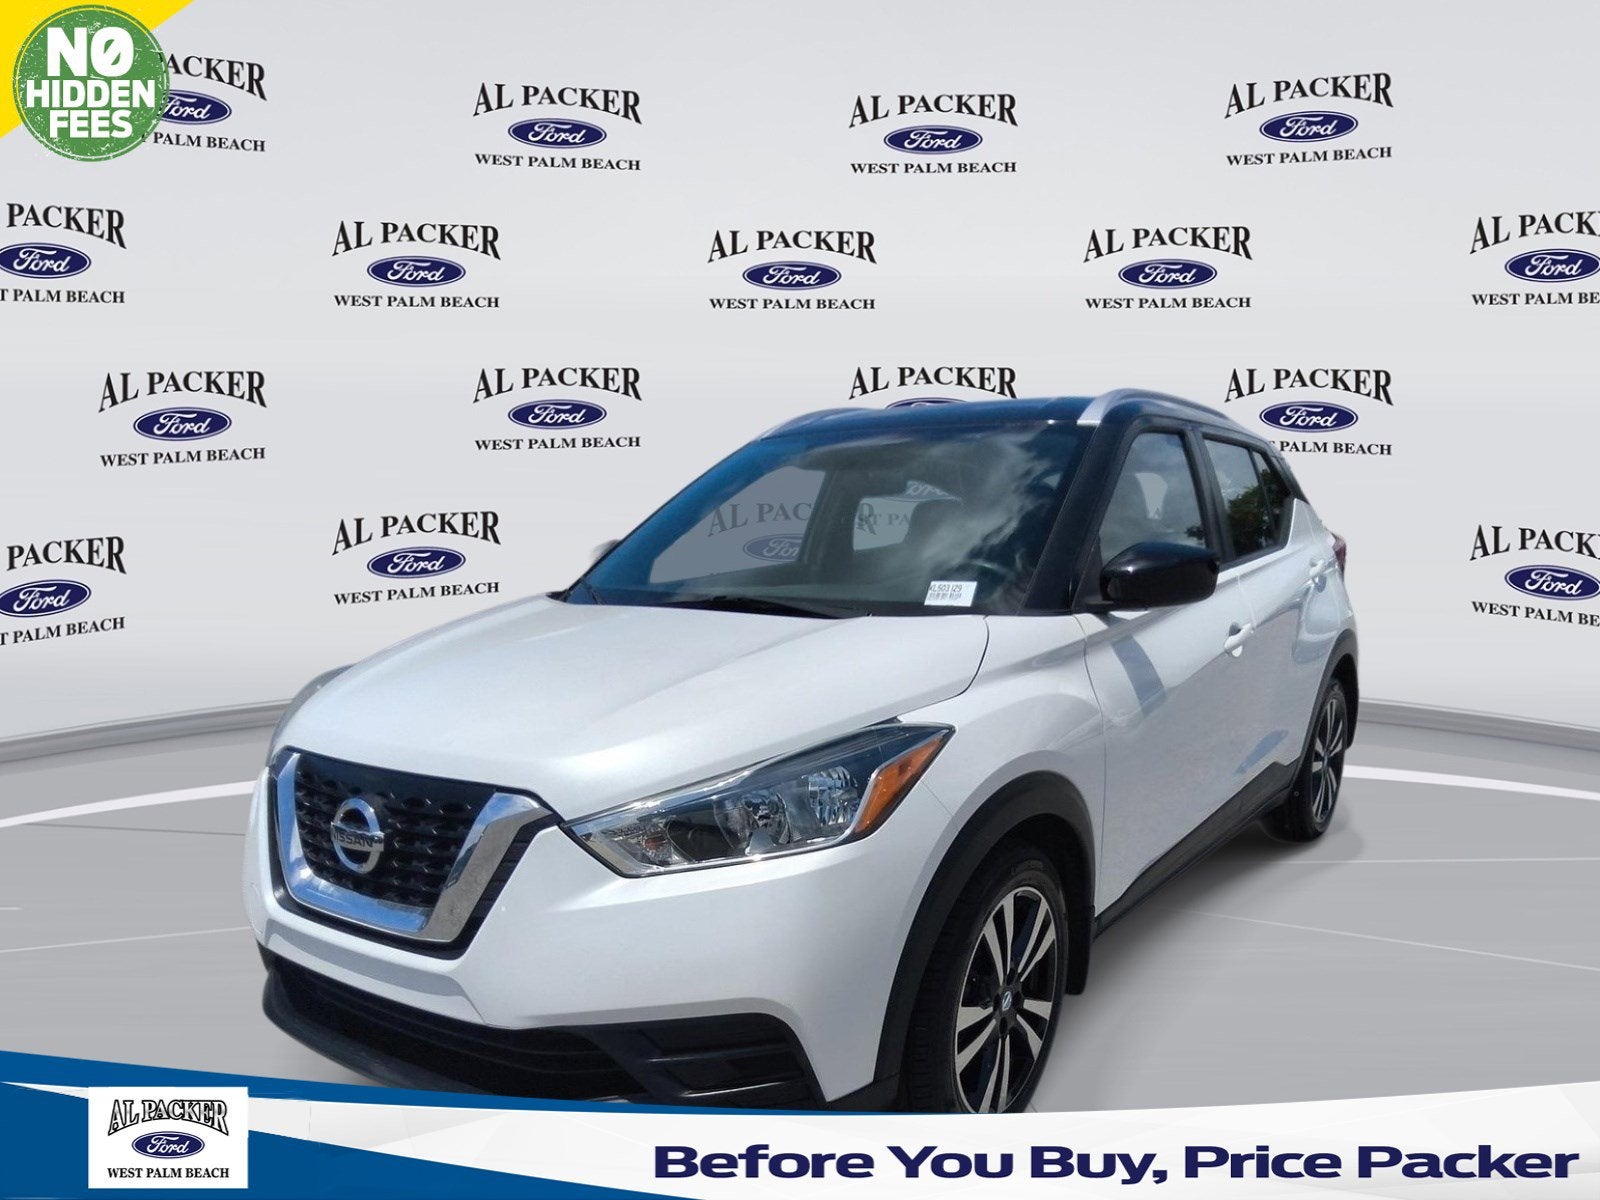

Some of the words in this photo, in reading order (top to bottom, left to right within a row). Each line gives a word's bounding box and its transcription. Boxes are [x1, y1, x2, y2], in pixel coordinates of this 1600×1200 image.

[165, 53, 267, 101] ACKER
[473, 83, 513, 116] AL
[522, 85, 642, 124] PACKER
[1225, 83, 1265, 119] AL
[1273, 73, 1393, 107] PACKER
[161, 97, 211, 119] Ford
[849, 96, 889, 128] AL
[898, 94, 1018, 126] PACKER
[528, 123, 586, 143] Ford
[1280, 117, 1337, 137] Ford
[154, 132, 202, 148] PALM
[207, 137, 266, 152] BEACH
[904, 130, 962, 148] Ford
[475, 154, 523, 166] WEST
[528, 157, 576, 168] PALM
[582, 158, 640, 170] BEACH
[1227, 153, 1275, 165] WEST
[1280, 151, 1327, 163] PALM
[1334, 147, 1391, 160] BEACH
[851, 163, 899, 173] WEST
[904, 163, 952, 173] PALM
[958, 162, 1016, 173] BEACH
[7, 203, 126, 249] PACKER
[1470, 216, 1510, 254] AL
[1519, 211, 1600, 238] PACK
[332, 221, 372, 256] AL
[381, 222, 501, 260] PACKER
[708, 230, 748, 263] AL
[756, 231, 876, 264] PACKER
[1084, 229, 1124, 263] AL
[1132, 226, 1252, 260] PACKER
[13, 248, 70, 272] Ford
[1525, 255, 1582, 276] Ford
[387, 261, 445, 281] Ford
[763, 266, 821, 284] Ford
[1139, 264, 1196, 283] Ford
[13, 289, 61, 302] PALM
[66, 291, 124, 303] BEACH
[334, 295, 382, 307] WEST
[388, 296, 435, 307] PALM
[441, 297, 499, 308] BEACH
[710, 299, 758, 309] WEST
[763, 299, 810, 309] PALM
[816, 299, 875, 309] BEACH
[1086, 298, 1134, 309] WEST
[1139, 298, 1186, 308] PALM
[1192, 297, 1251, 308] BEACH
[1472, 294, 1520, 305] WEST
[1525, 293, 1573, 304] PALM
[99, 373, 139, 413] AL
[147, 371, 267, 408] PACKER
[473, 368, 513, 403] AL
[522, 368, 642, 401] PACKER
[849, 367, 889, 400] AL
[898, 367, 1018, 400] PACKER
[1225, 369, 1265, 403] AL
[1273, 369, 1393, 406] PACKER
[154, 413, 211, 434] Ford
[528, 405, 586, 423] Ford
[1280, 406, 1337, 426] Ford
[475, 439, 523, 450] WEST
[528, 438, 576, 449] PALM
[582, 437, 640, 448] BEACH
[1280, 441, 1328, 453] PALM
[1333, 443, 1392, 455] BEACH
[100, 453, 149, 466] WEST
[154, 451, 201, 464] PALM
[207, 448, 265, 461] BEACH
[332, 518, 373, 555] AL
[381, 511, 501, 545] PACKER
[1470, 525, 1510, 561] AL
[1518, 528, 1600, 560] PACK
[7, 536, 126, 574] PACKER
[387, 553, 445, 573] Ford
[334, 590, 382, 604] WEST
[388, 586, 435, 600] PALM
[441, 582, 499, 596] BEACH
[1525, 570, 1582, 595] Ford
[13, 586, 71, 611] Ford
[1472, 601, 1520, 617] WEST
[1525, 607, 1573, 623] PALM
[13, 625, 61, 643] PALM
[67, 617, 124, 636] BEACH
[333, 831, 373, 848] NISSAN
